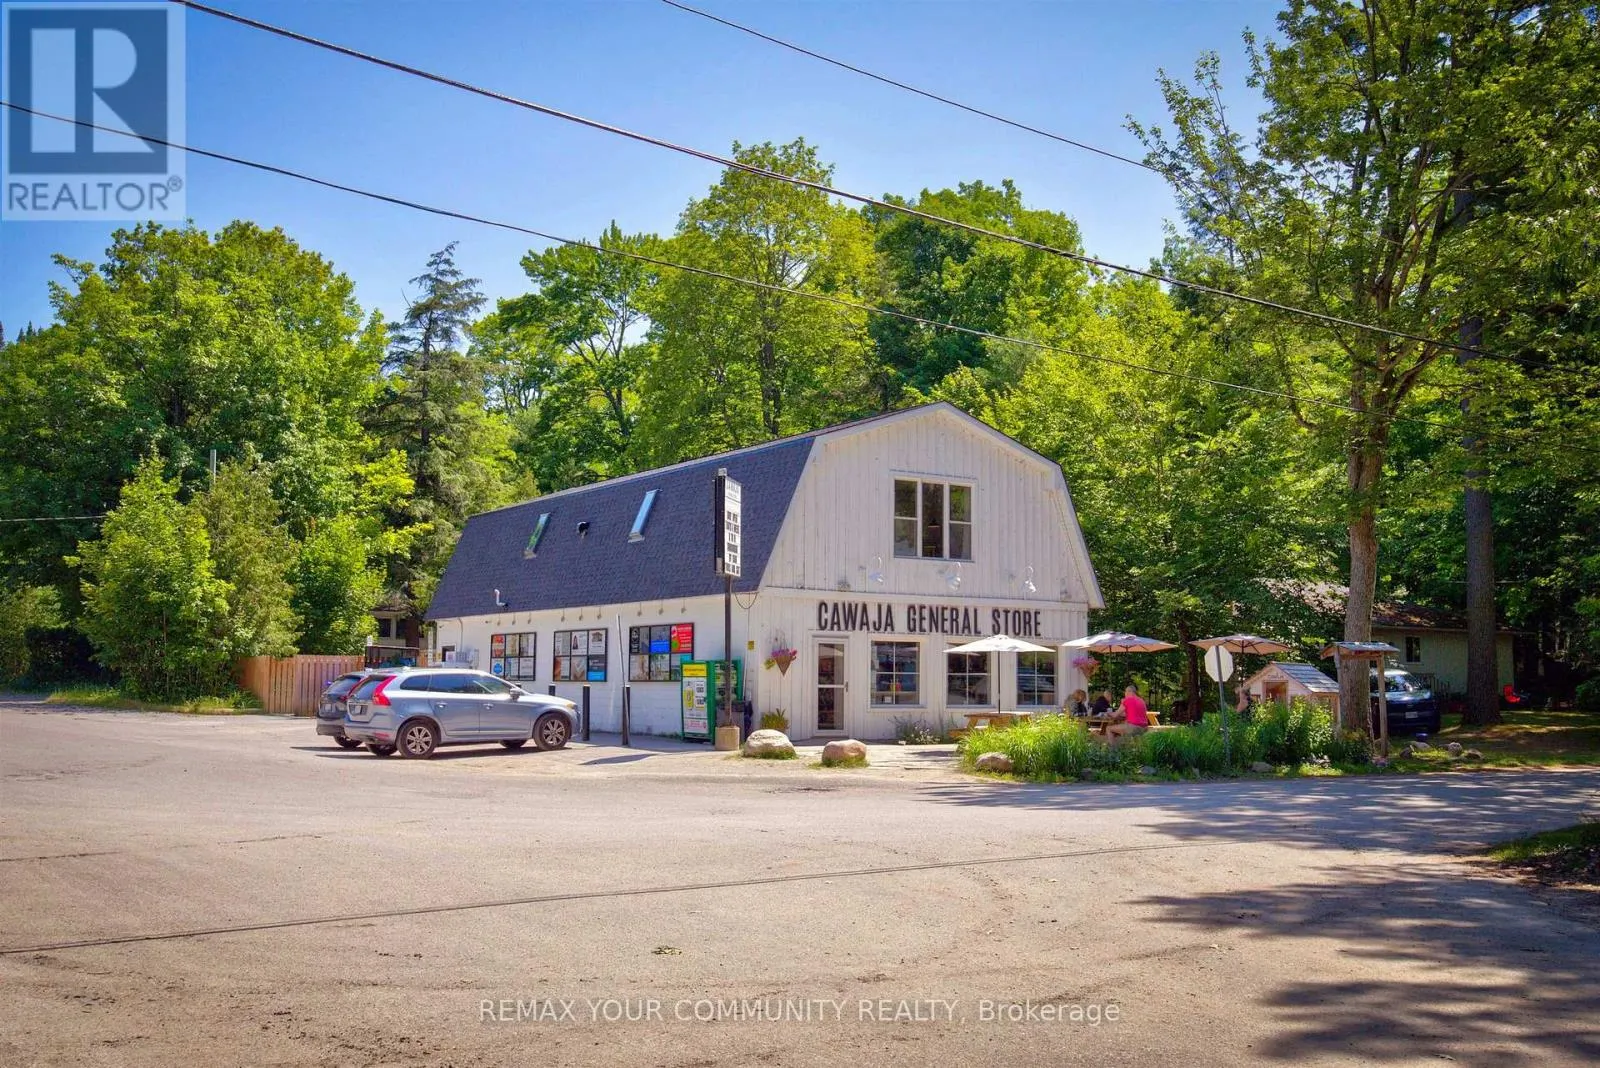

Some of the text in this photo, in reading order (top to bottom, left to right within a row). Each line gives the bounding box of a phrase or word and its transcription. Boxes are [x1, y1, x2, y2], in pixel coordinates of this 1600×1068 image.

[818, 601, 1042, 637] CAWAJA GENERAL STORE
